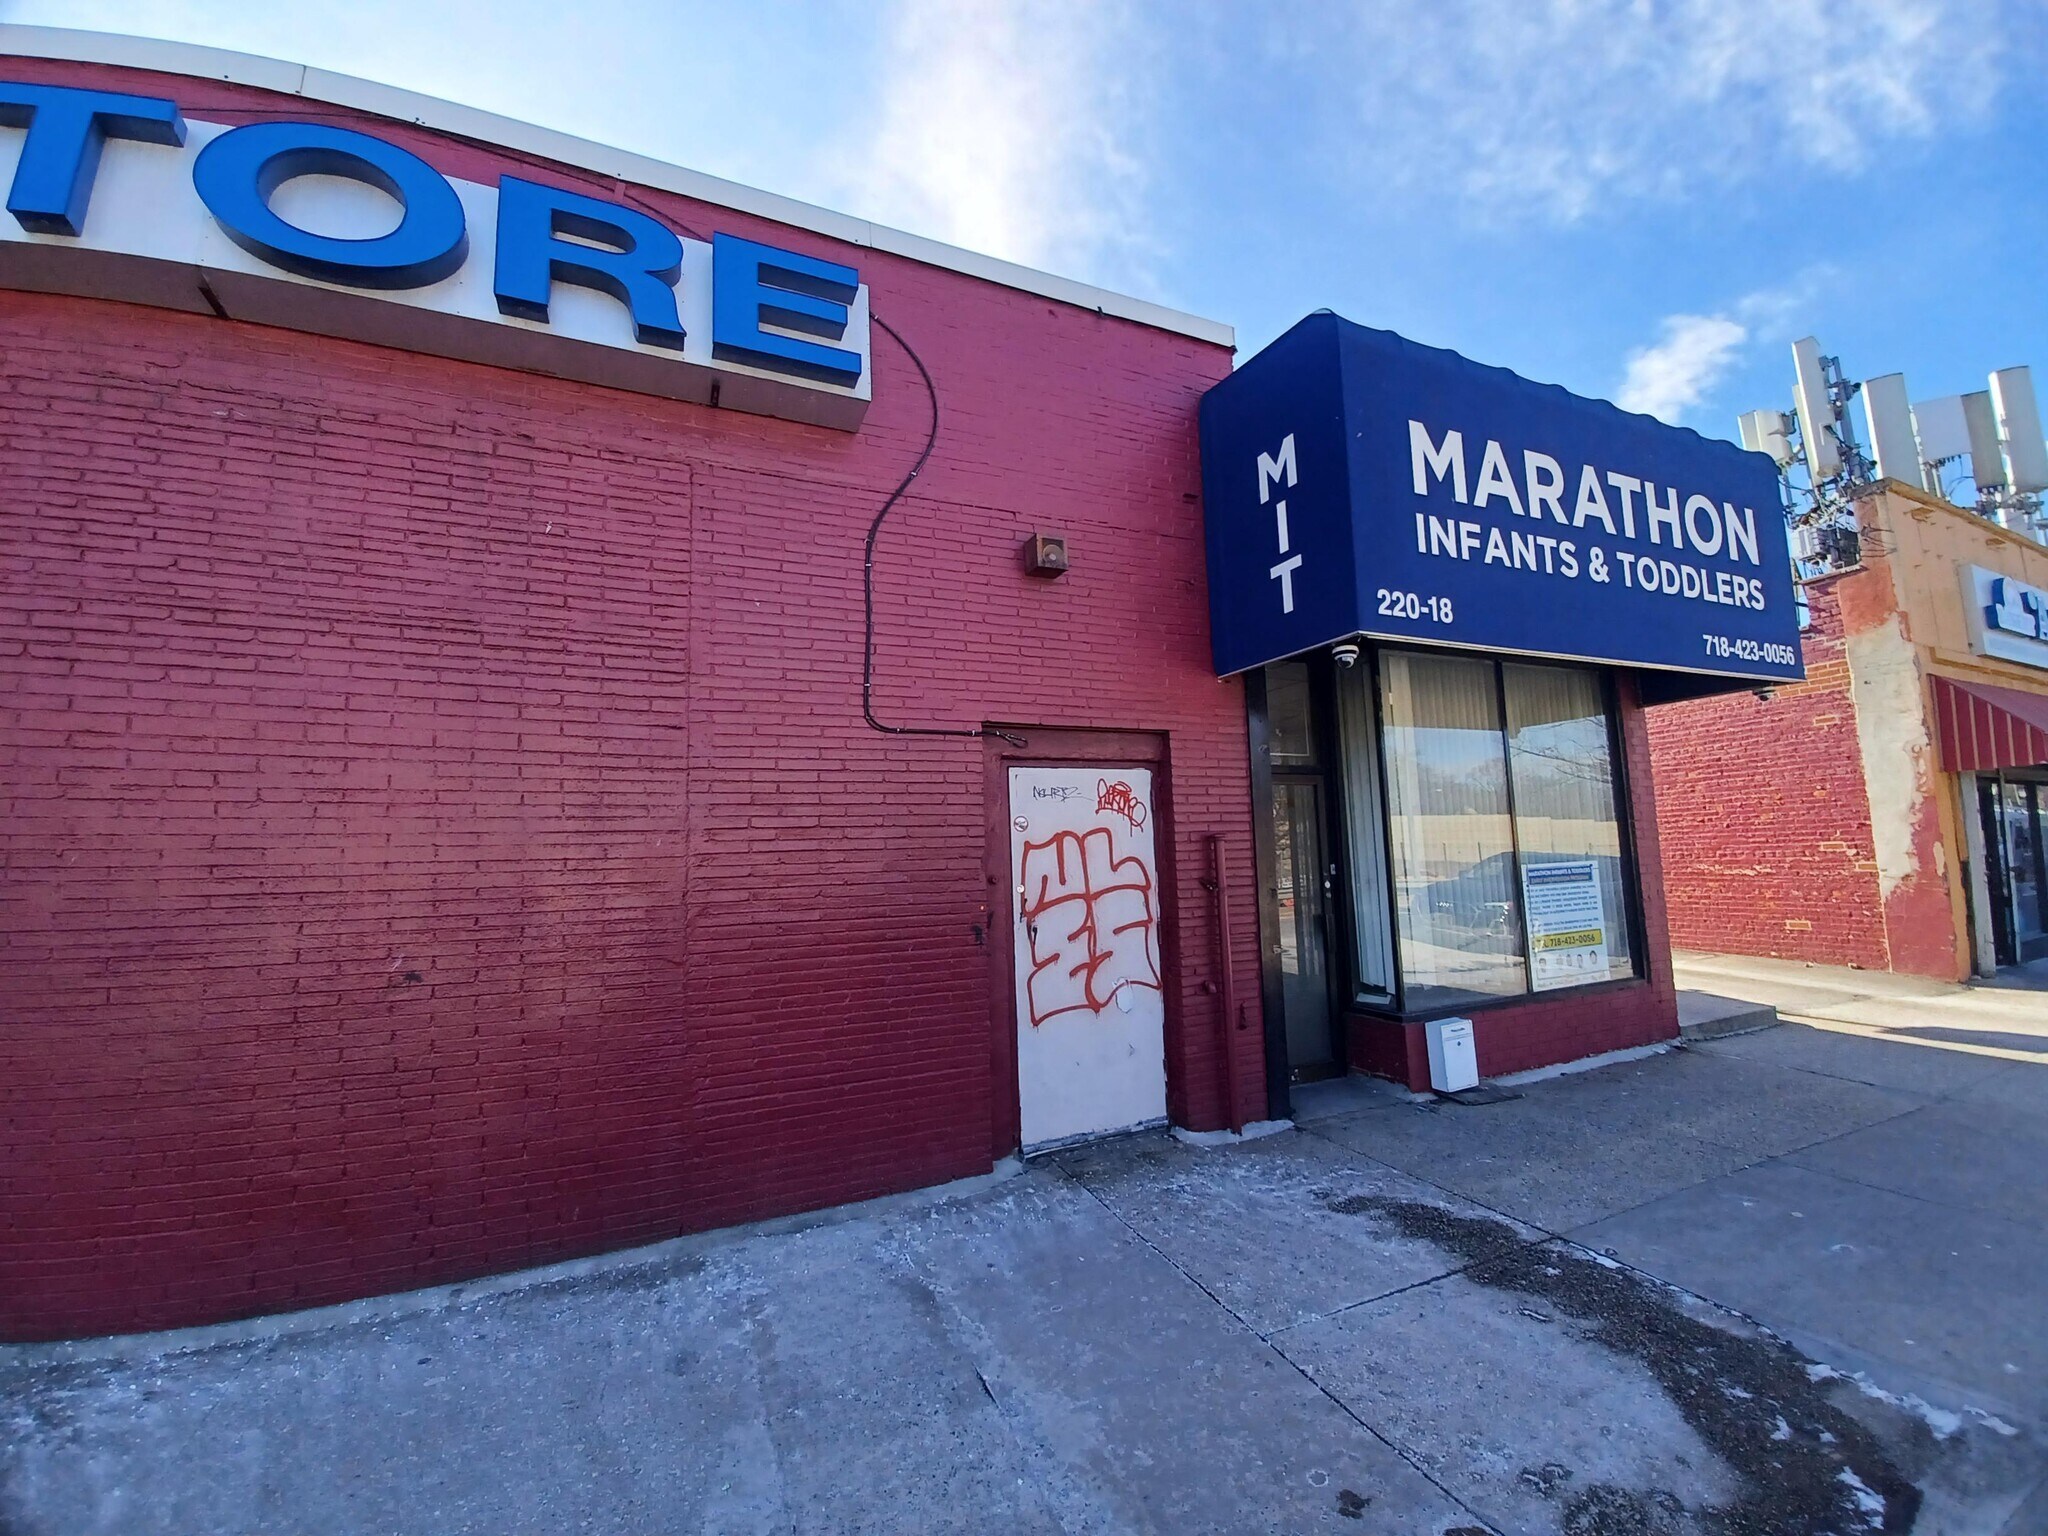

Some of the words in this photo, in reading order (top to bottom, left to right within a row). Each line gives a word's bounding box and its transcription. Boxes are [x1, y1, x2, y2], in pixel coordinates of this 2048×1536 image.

[1408, 419, 1761, 567] MARATHON
[1415, 513, 1580, 580] INFANTS
[1588, 546, 1611, 585] &
[1616, 551, 1765, 611] TODDLERS
[1377, 588, 1454, 624] 220-18
[1702, 633, 1796, 666] 718-423-0056
